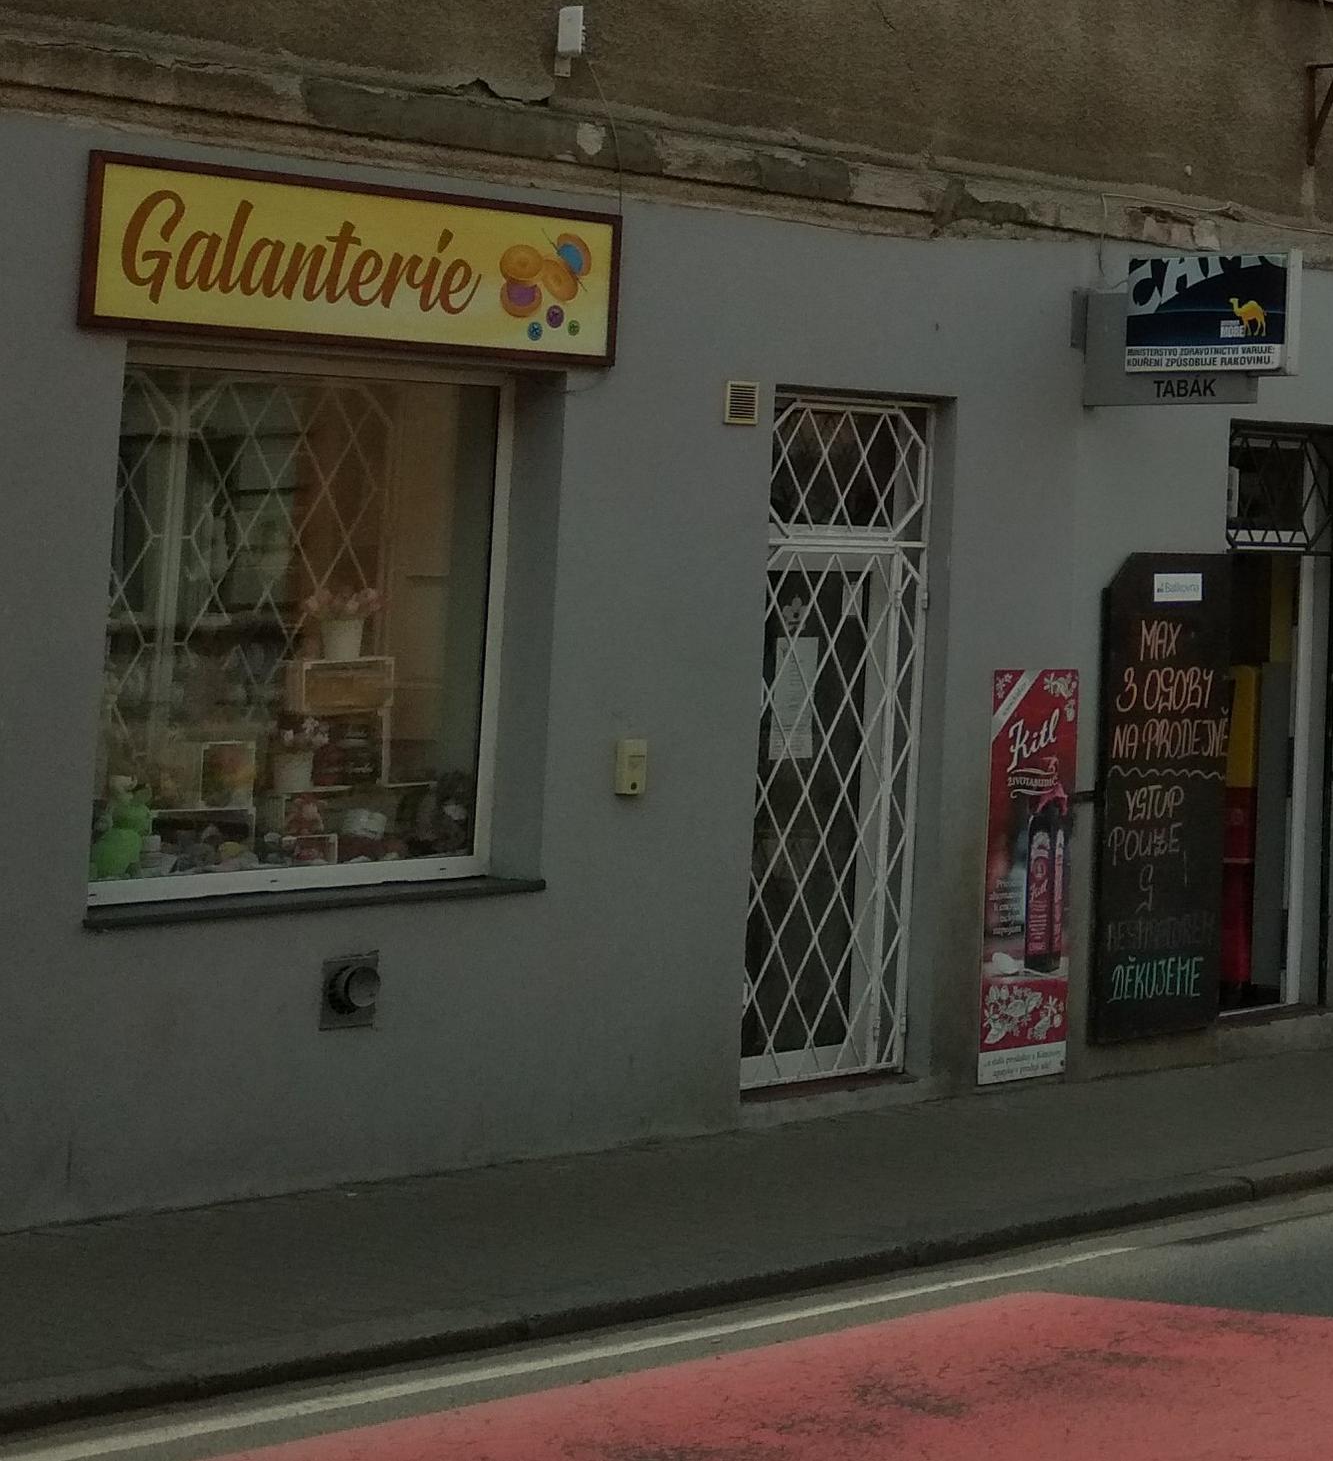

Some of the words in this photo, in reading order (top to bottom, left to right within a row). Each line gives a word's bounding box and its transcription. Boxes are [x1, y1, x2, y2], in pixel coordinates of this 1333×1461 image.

[122, 190, 482, 316] Galanterie
[1154, 376, 1216, 398] TABÁK
[1140, 620, 1183, 661] MAX
[1116, 667, 1138, 712] 3
[1144, 667, 1215, 713] OSOBY
[1007, 708, 1060, 772] Kitl
[1112, 724, 1139, 760] NA
[1142, 706, 1230, 761] PRODEJNĚ
[1125, 784, 1184, 821] VSTUP
[1106, 956, 1204, 1004] DĚKUJEME
